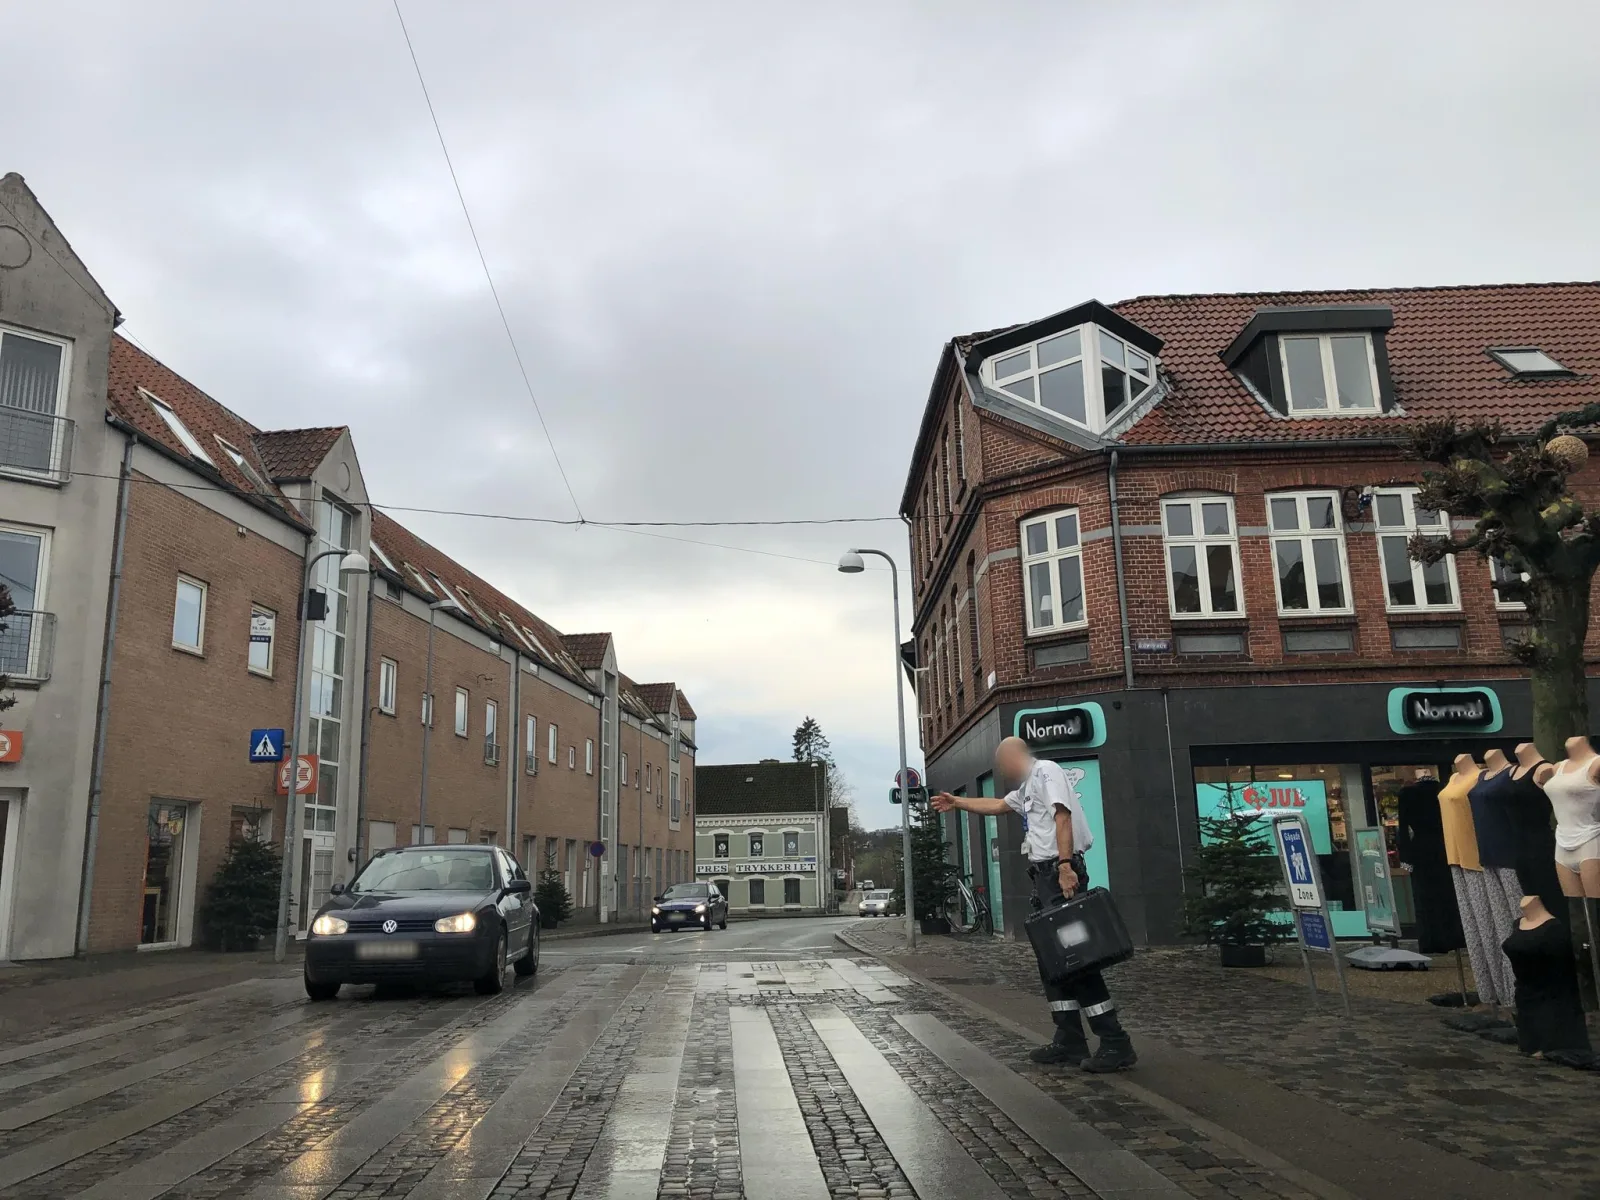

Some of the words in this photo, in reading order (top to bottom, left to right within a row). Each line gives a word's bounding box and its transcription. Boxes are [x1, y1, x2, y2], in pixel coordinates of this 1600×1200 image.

[1415, 698, 1484, 719] Normal
[1268, 788, 1306, 808] JUL
[697, 865, 728, 873] PRES
[736, 862, 816, 872] TRYKKERIET
[1297, 888, 1314, 900] Zone
